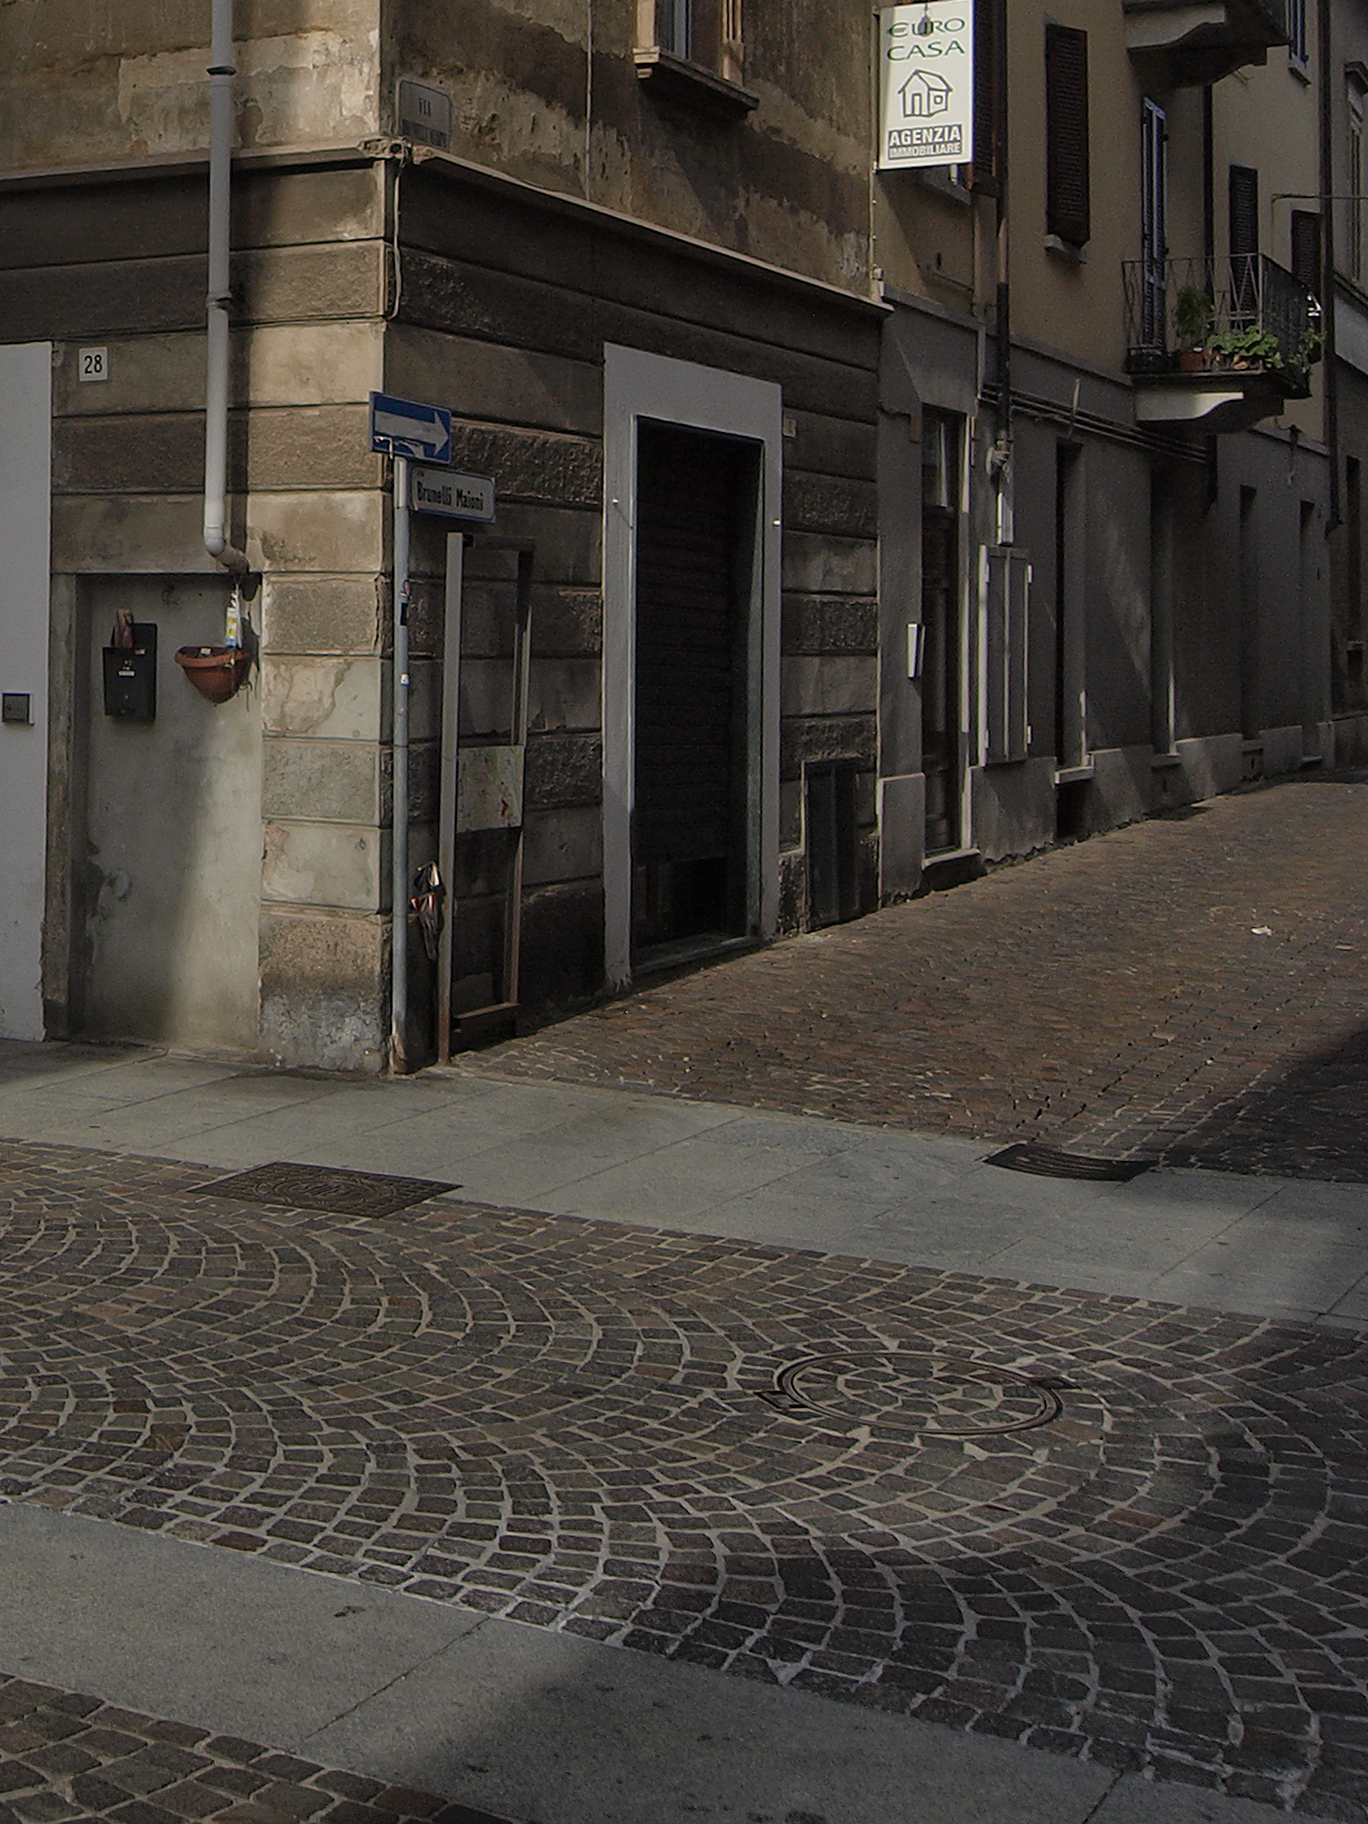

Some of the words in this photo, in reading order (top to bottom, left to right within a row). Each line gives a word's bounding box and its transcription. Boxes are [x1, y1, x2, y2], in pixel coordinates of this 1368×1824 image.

[887, 40, 965, 61] CASA
[889, 125, 962, 147] AGENZIA
[890, 142, 962, 158] IMMOBILIARE
[84, 354, 103, 374] 28
[417, 480, 452, 505] Brunelli
[456, 488, 483, 511] Maioni
